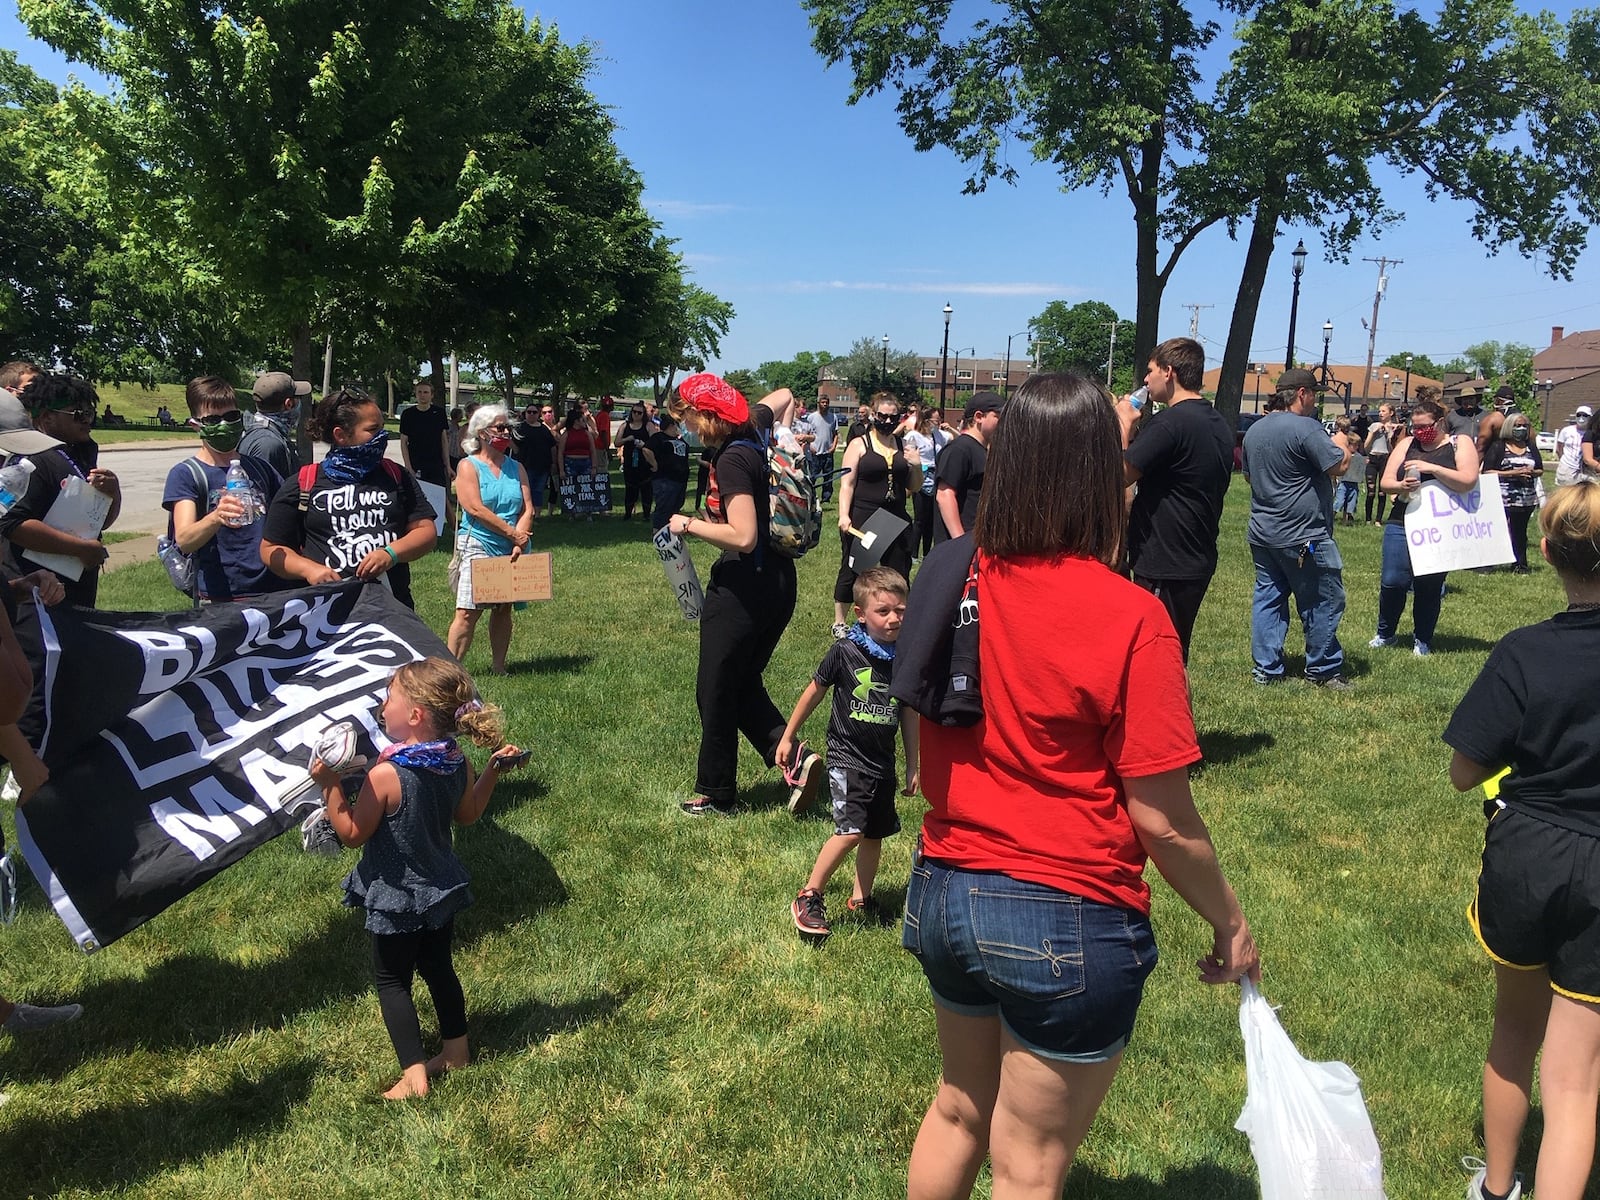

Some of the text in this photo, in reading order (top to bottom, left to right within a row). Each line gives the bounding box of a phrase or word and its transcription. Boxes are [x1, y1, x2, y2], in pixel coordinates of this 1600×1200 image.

[312, 484, 392, 514] Tell me
[1429, 490, 1483, 518] Love
[331, 507, 388, 538] your
[1411, 517, 1493, 546] one another
[474, 562, 506, 576] Equality
[115, 592, 343, 695] BLACK
[100, 620, 427, 791] LIVES
